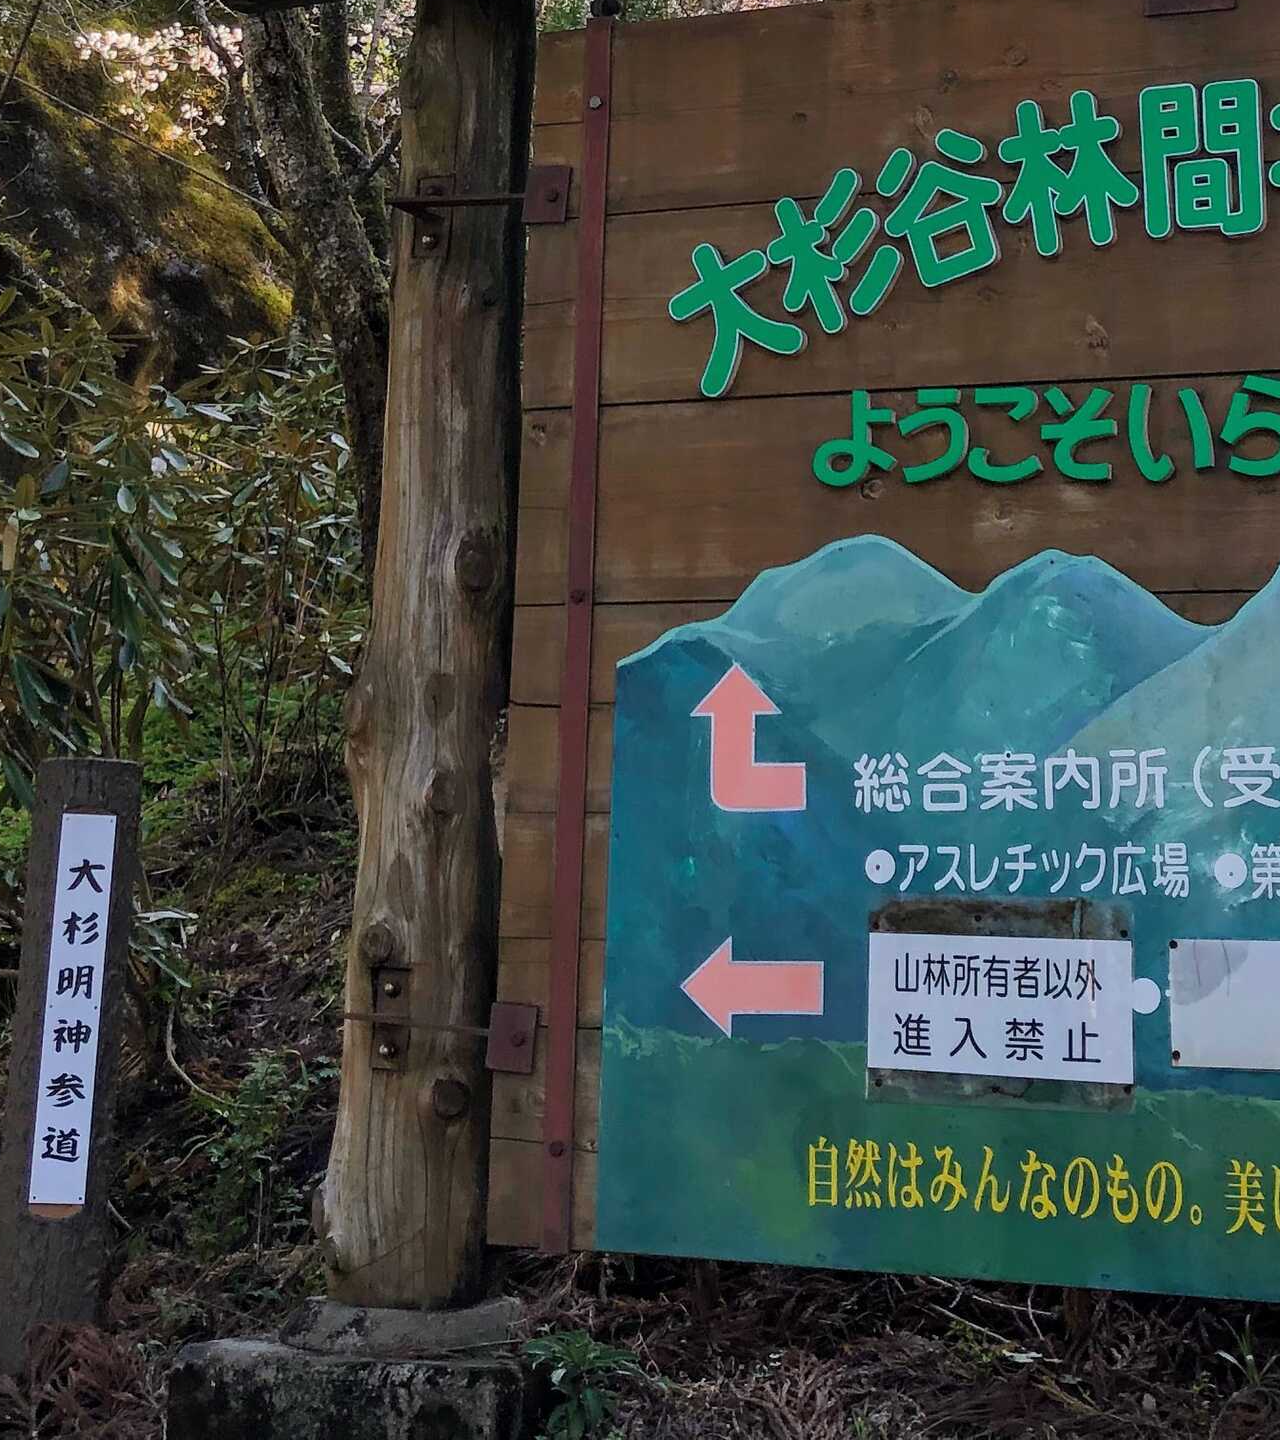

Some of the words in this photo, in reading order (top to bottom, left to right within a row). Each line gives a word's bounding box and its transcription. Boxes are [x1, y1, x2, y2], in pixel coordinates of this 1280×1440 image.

[897, 841, 1191, 899] アスレチック広場
[893, 952, 1103, 1002] 山林所有者以外
[41, 858, 106, 1163] 大杉明神参道
[892, 1013, 1103, 1065] 進入禁止
